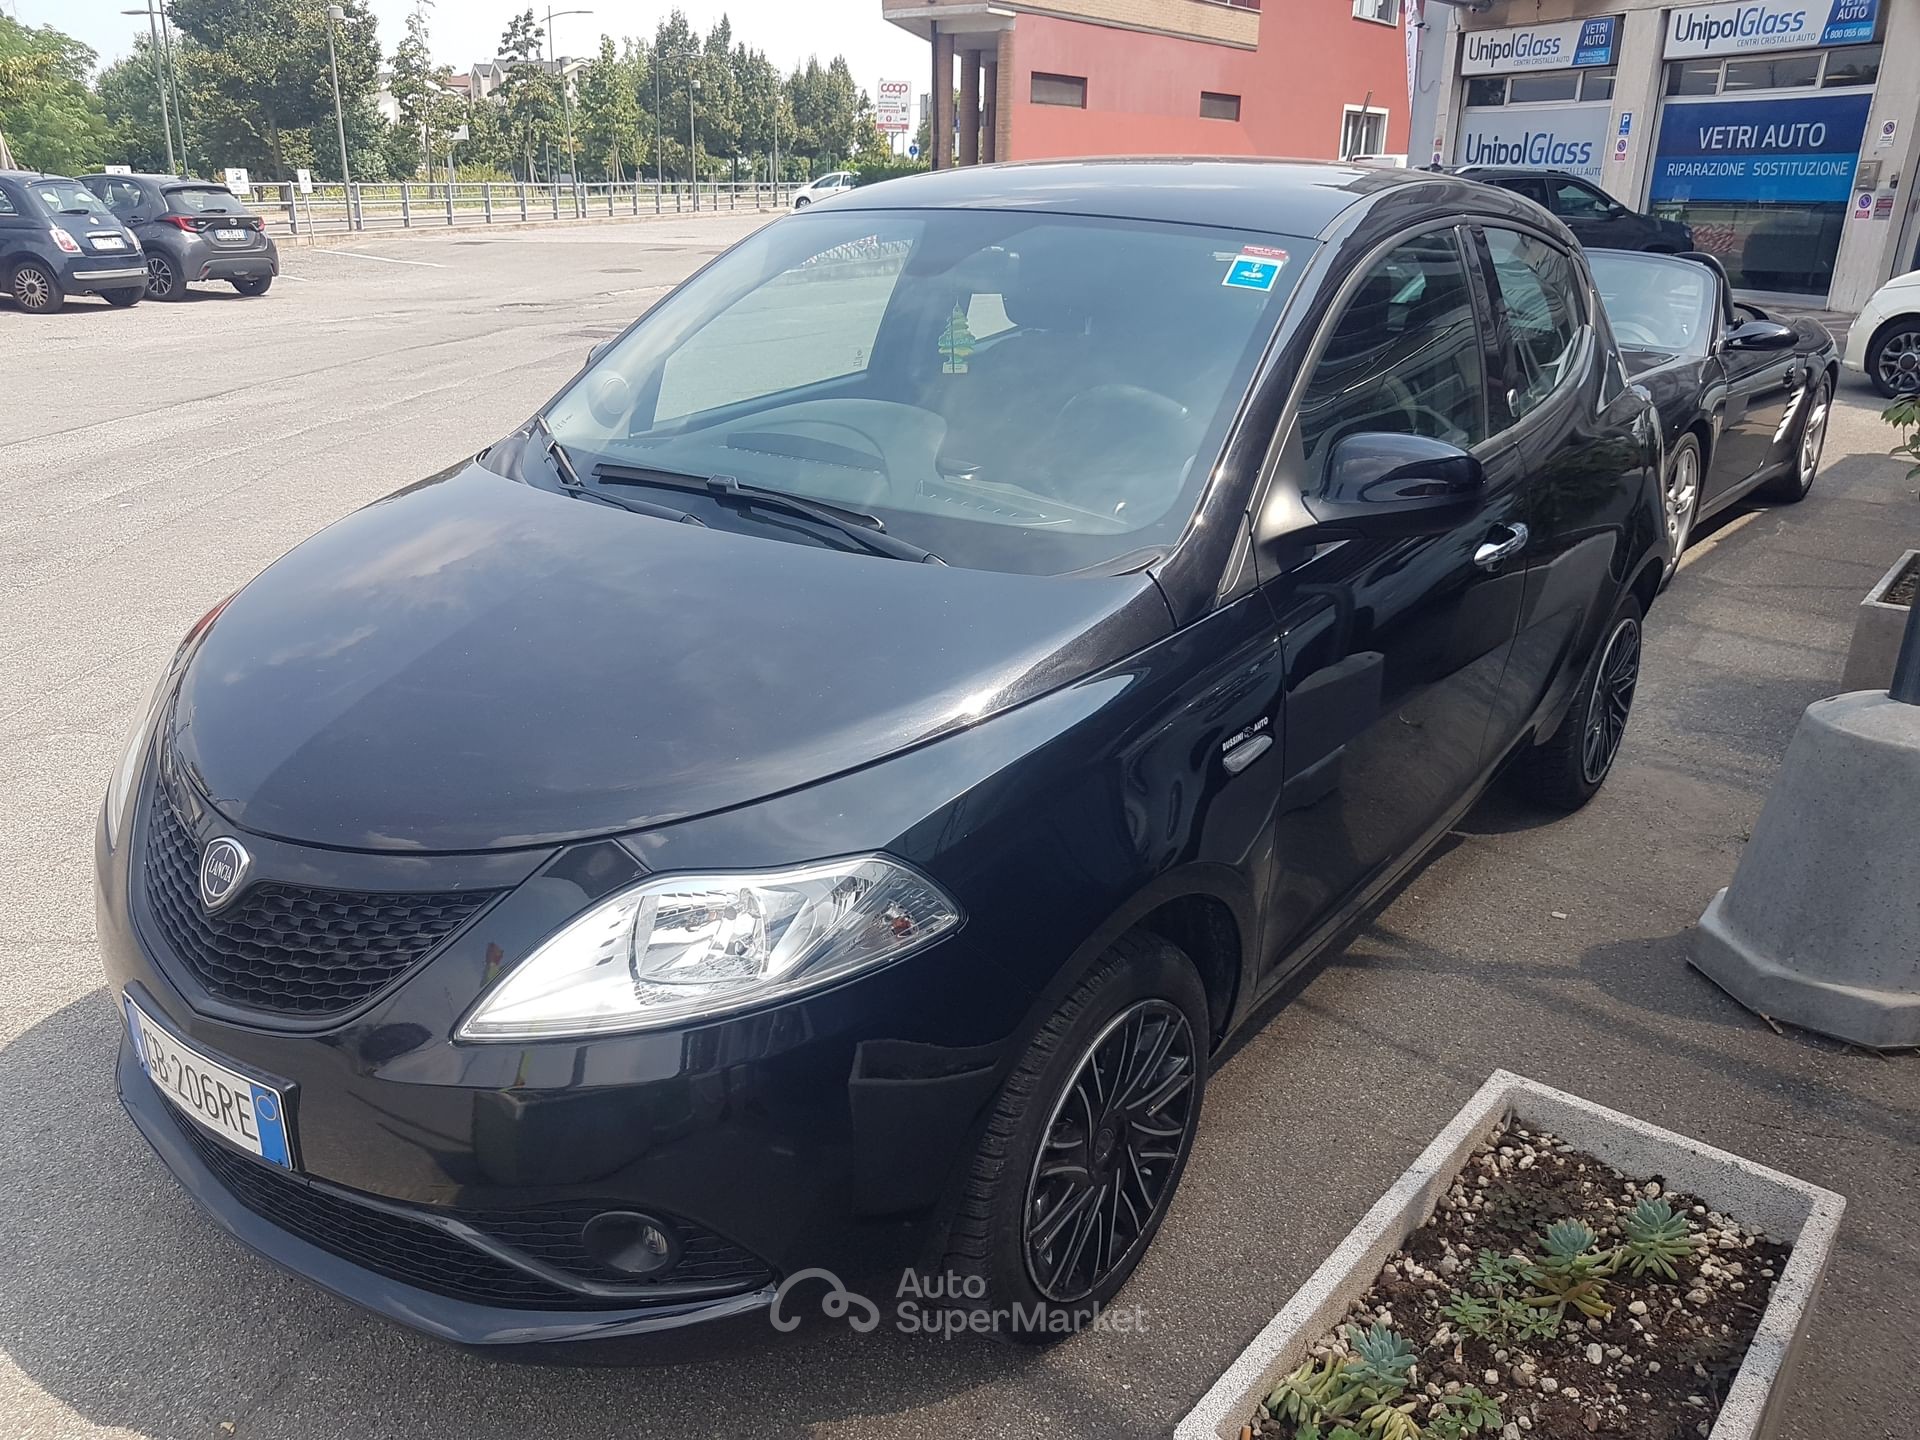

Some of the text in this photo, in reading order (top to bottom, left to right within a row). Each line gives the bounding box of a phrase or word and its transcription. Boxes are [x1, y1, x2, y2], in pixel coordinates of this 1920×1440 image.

[1836, 7, 1867, 21] AUTO
[1585, 22, 1608, 34] VETRI
[1674, 7, 1806, 50] UnipolGlass
[1583, 34, 1606, 46] AUTO
[1736, 33, 1816, 47] CENTRI CRISTALLI AUTO
[1468, 33, 1562, 68] UnipolGlass
[1513, 59, 1531, 67] CENTRI
[1531, 57, 1556, 65] CRISTALLI
[880, 83, 908, 95] coop
[1699, 122, 1826, 149] VETRI AUTO
[1667, 161, 1850, 176] RIPARAZIONE SOSTITUZIONE
[208, 858, 233, 883] LANCIA
